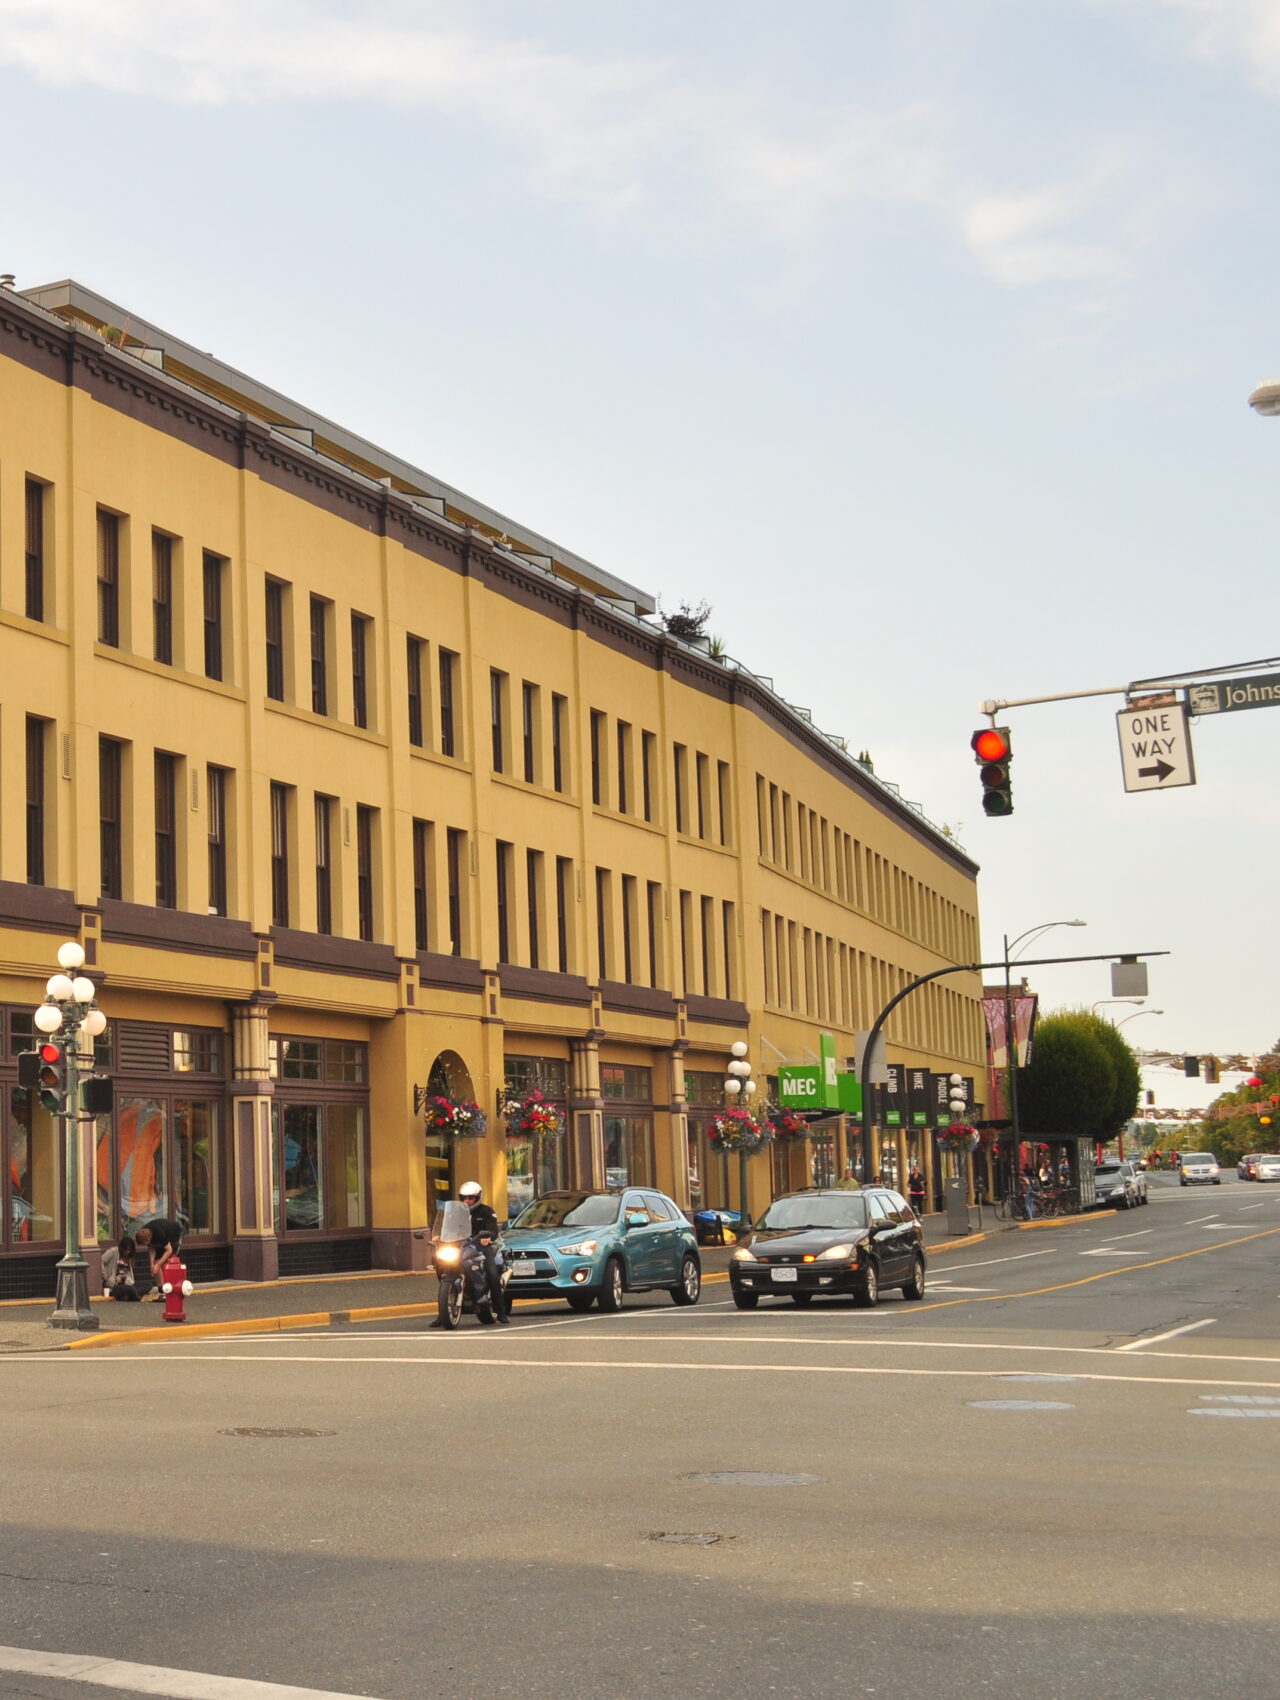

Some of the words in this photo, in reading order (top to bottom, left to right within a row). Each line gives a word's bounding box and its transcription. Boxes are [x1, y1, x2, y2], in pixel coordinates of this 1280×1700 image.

[1132, 714, 1171, 736] ONE
[1131, 737, 1176, 758] WAY
[782, 1078, 816, 1096] MEC
[887, 1068, 898, 1093] CLIMB
[913, 1072, 924, 1090] HIKE
[937, 1076, 948, 1104] PADDLE
